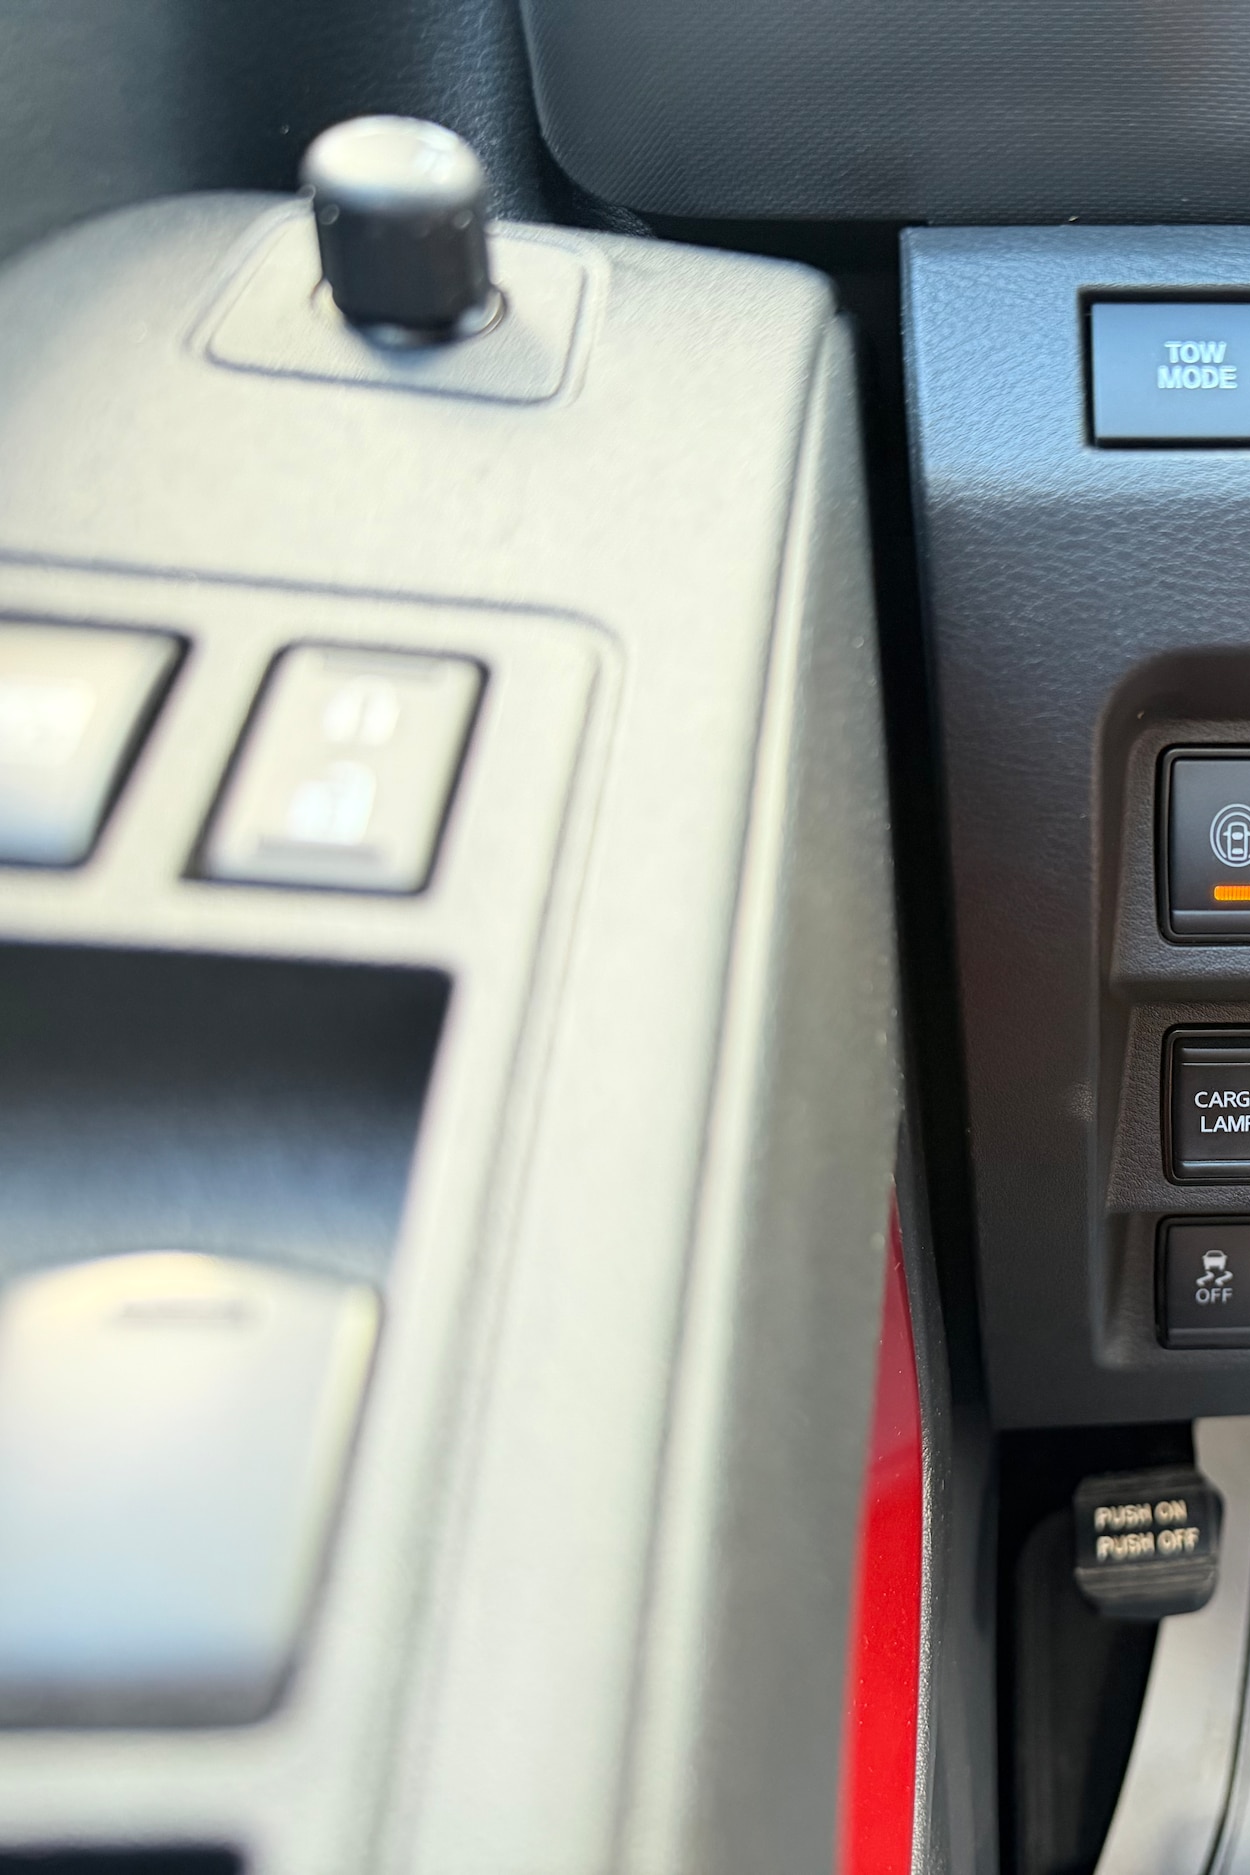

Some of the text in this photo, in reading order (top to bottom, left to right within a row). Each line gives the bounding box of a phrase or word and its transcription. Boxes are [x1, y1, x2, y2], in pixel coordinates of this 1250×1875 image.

[1164, 341, 1227, 364] TOW
[1157, 364, 1238, 390] MODE
[1195, 1288, 1233, 1304] OFF
[1094, 1500, 1187, 1532] PUSH ON
[1096, 1527, 1200, 1562] PUSH OFF
